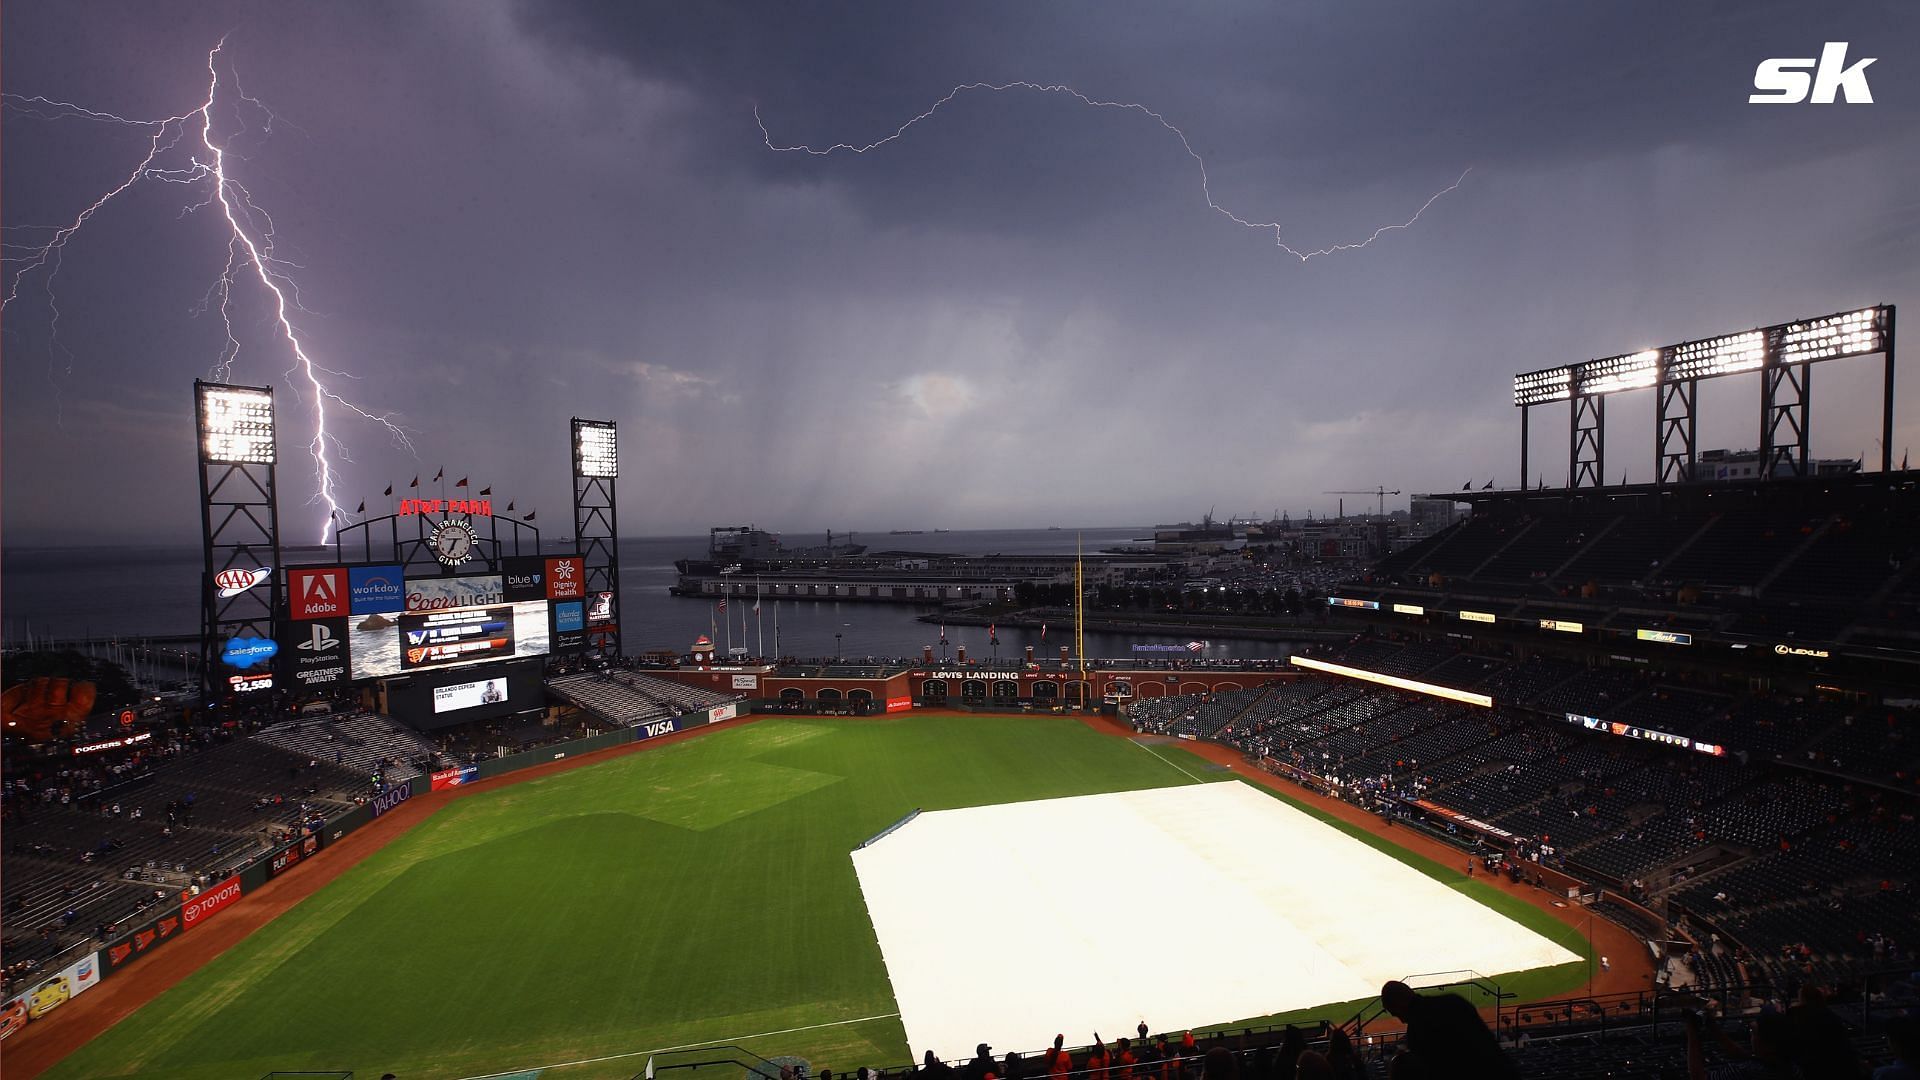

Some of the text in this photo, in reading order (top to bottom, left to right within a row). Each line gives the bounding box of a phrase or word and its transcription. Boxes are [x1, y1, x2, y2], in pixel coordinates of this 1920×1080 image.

[399, 499, 492, 517] AT&T PARK
[429, 519, 479, 546] SAN FRANCISCO
[438, 554, 473, 566] GIANTS
[221, 571, 253, 588] AAA
[508, 574, 531, 585] blue
[553, 581, 577, 589] Dignity
[555, 589, 577, 597] Health
[406, 592, 504, 611] Coors LIGHT
[304, 602, 337, 614] Adobe
[229, 645, 273, 656] salesforce
[1788, 647, 1829, 658] LEXUS
[300, 654, 339, 664] PlayStation
[296, 667, 344, 679] GREATNESS
[966, 671, 1019, 679] LANDING
[233, 679, 273, 692] $2,550
[305, 674, 337, 685] AWAITS
[644, 720, 674, 737] VISA
[75, 741, 122, 754] DOCKERS
[432, 773, 448, 781] Bank
[454, 766, 477, 776] America
[373, 782, 410, 817] YAHOO!
[272, 855, 287, 871] PLAY
[200, 882, 241, 911] TOYOTA
